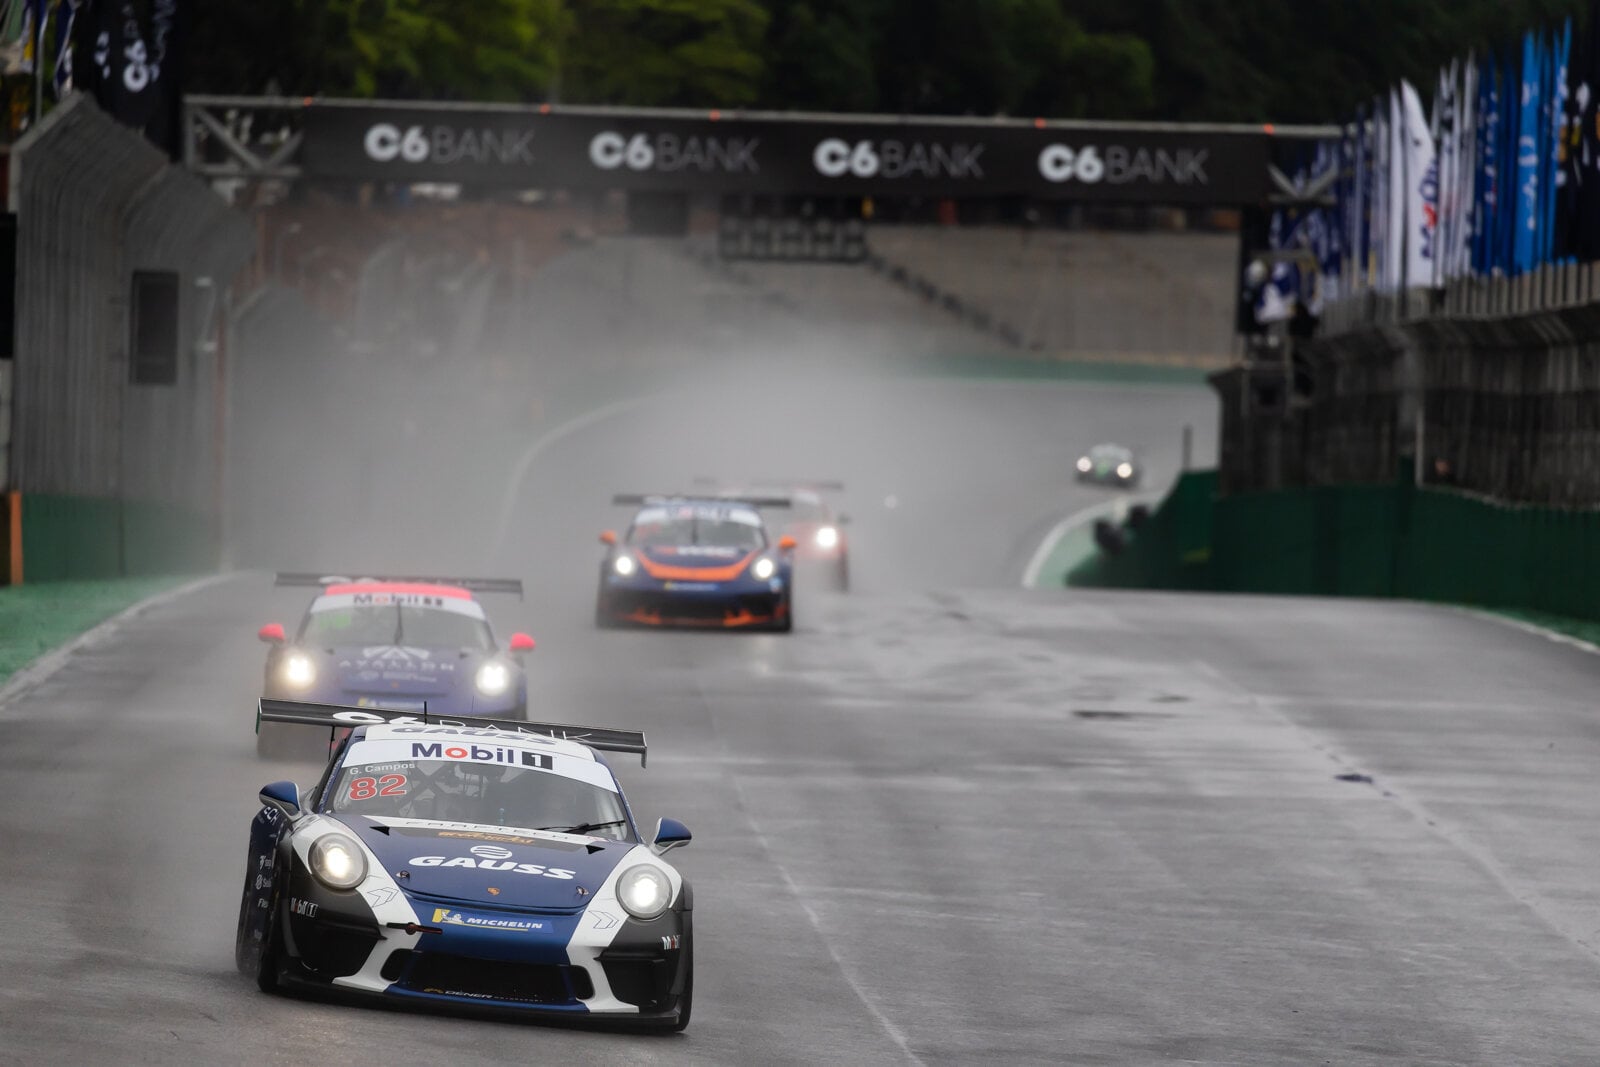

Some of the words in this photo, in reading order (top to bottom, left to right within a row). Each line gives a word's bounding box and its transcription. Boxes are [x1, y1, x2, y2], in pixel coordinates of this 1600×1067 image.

[412, 743, 514, 764] Mobil
[365, 763, 415, 772] Campos
[349, 773, 407, 800] 82
[408, 856, 577, 880] GAUSS
[467, 918, 543, 929] MICHELIN
[445, 990, 493, 999] DENER
